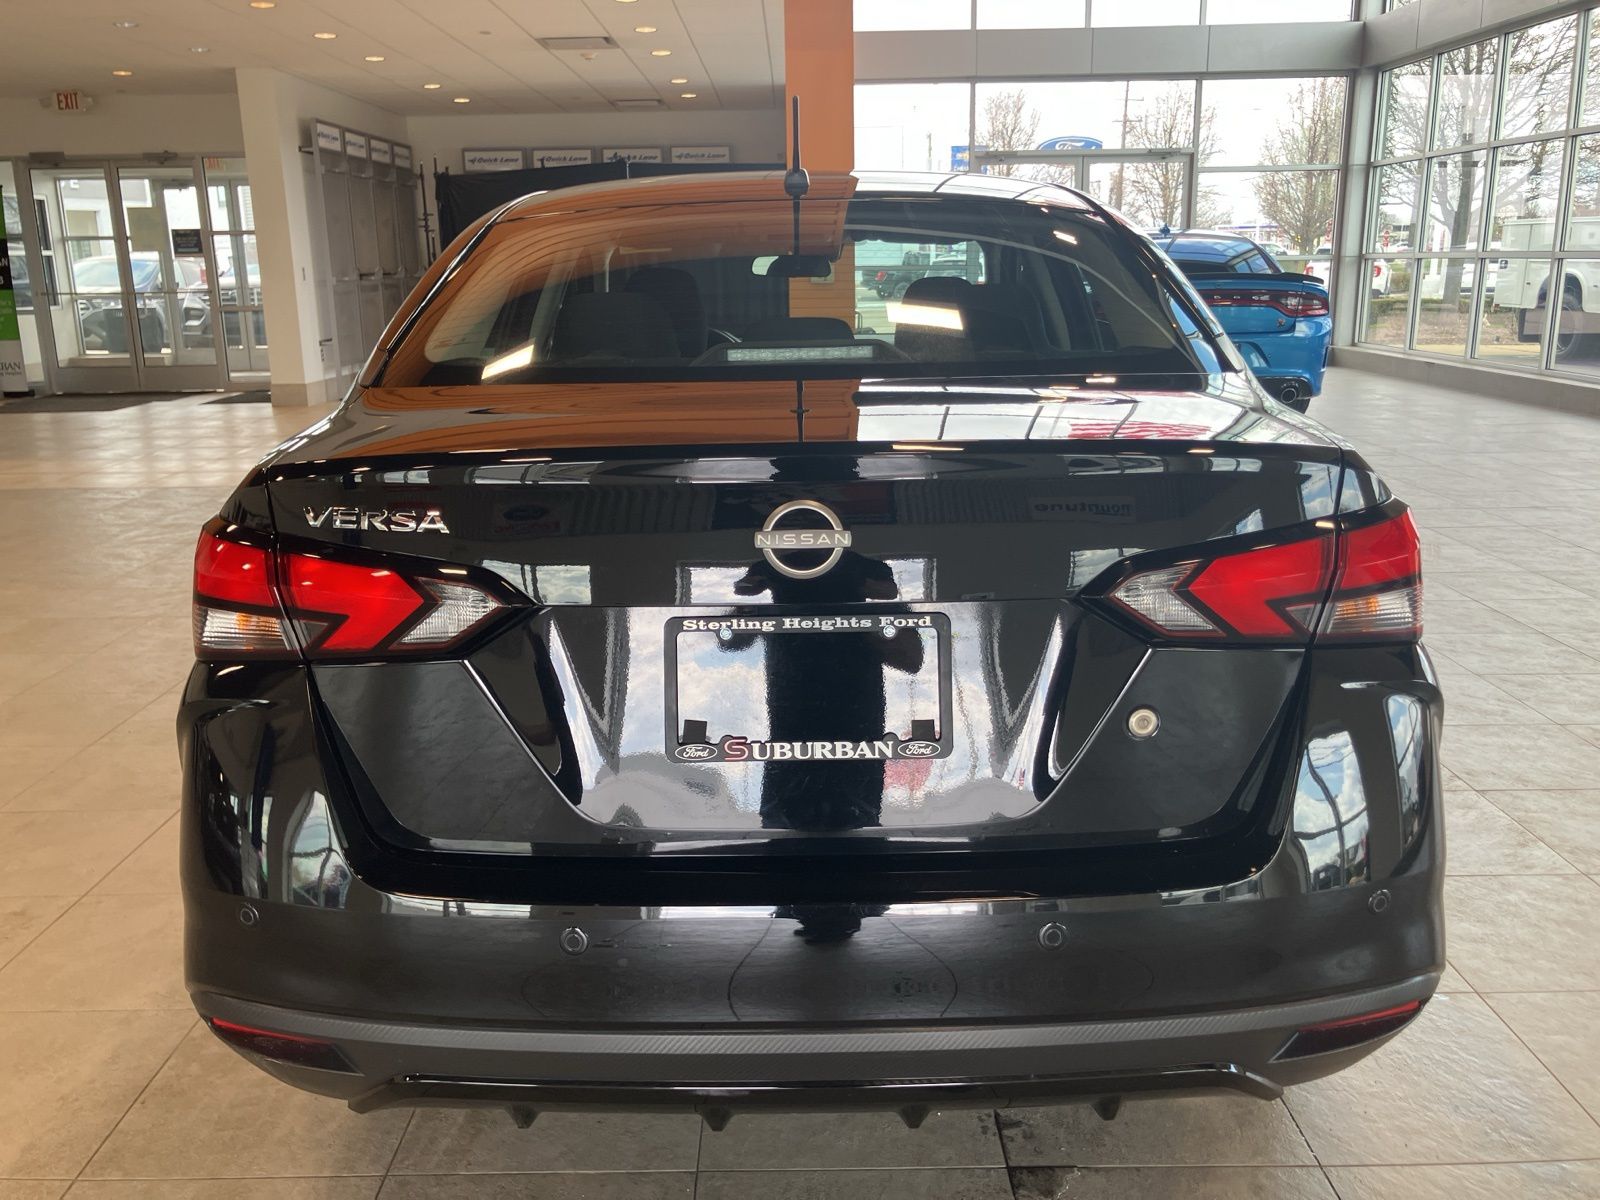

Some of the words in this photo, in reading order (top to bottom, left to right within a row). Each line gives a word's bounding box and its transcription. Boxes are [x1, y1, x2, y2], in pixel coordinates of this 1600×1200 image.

[56, 92, 80, 110] EXIT
[303, 506, 450, 535] VERSA
[757, 533, 849, 546] NISSAN
[682, 618, 776, 632] Sterling
[782, 617, 872, 630] Heights
[878, 616, 933, 628] Ford
[724, 739, 894, 761] SUBURBAN
